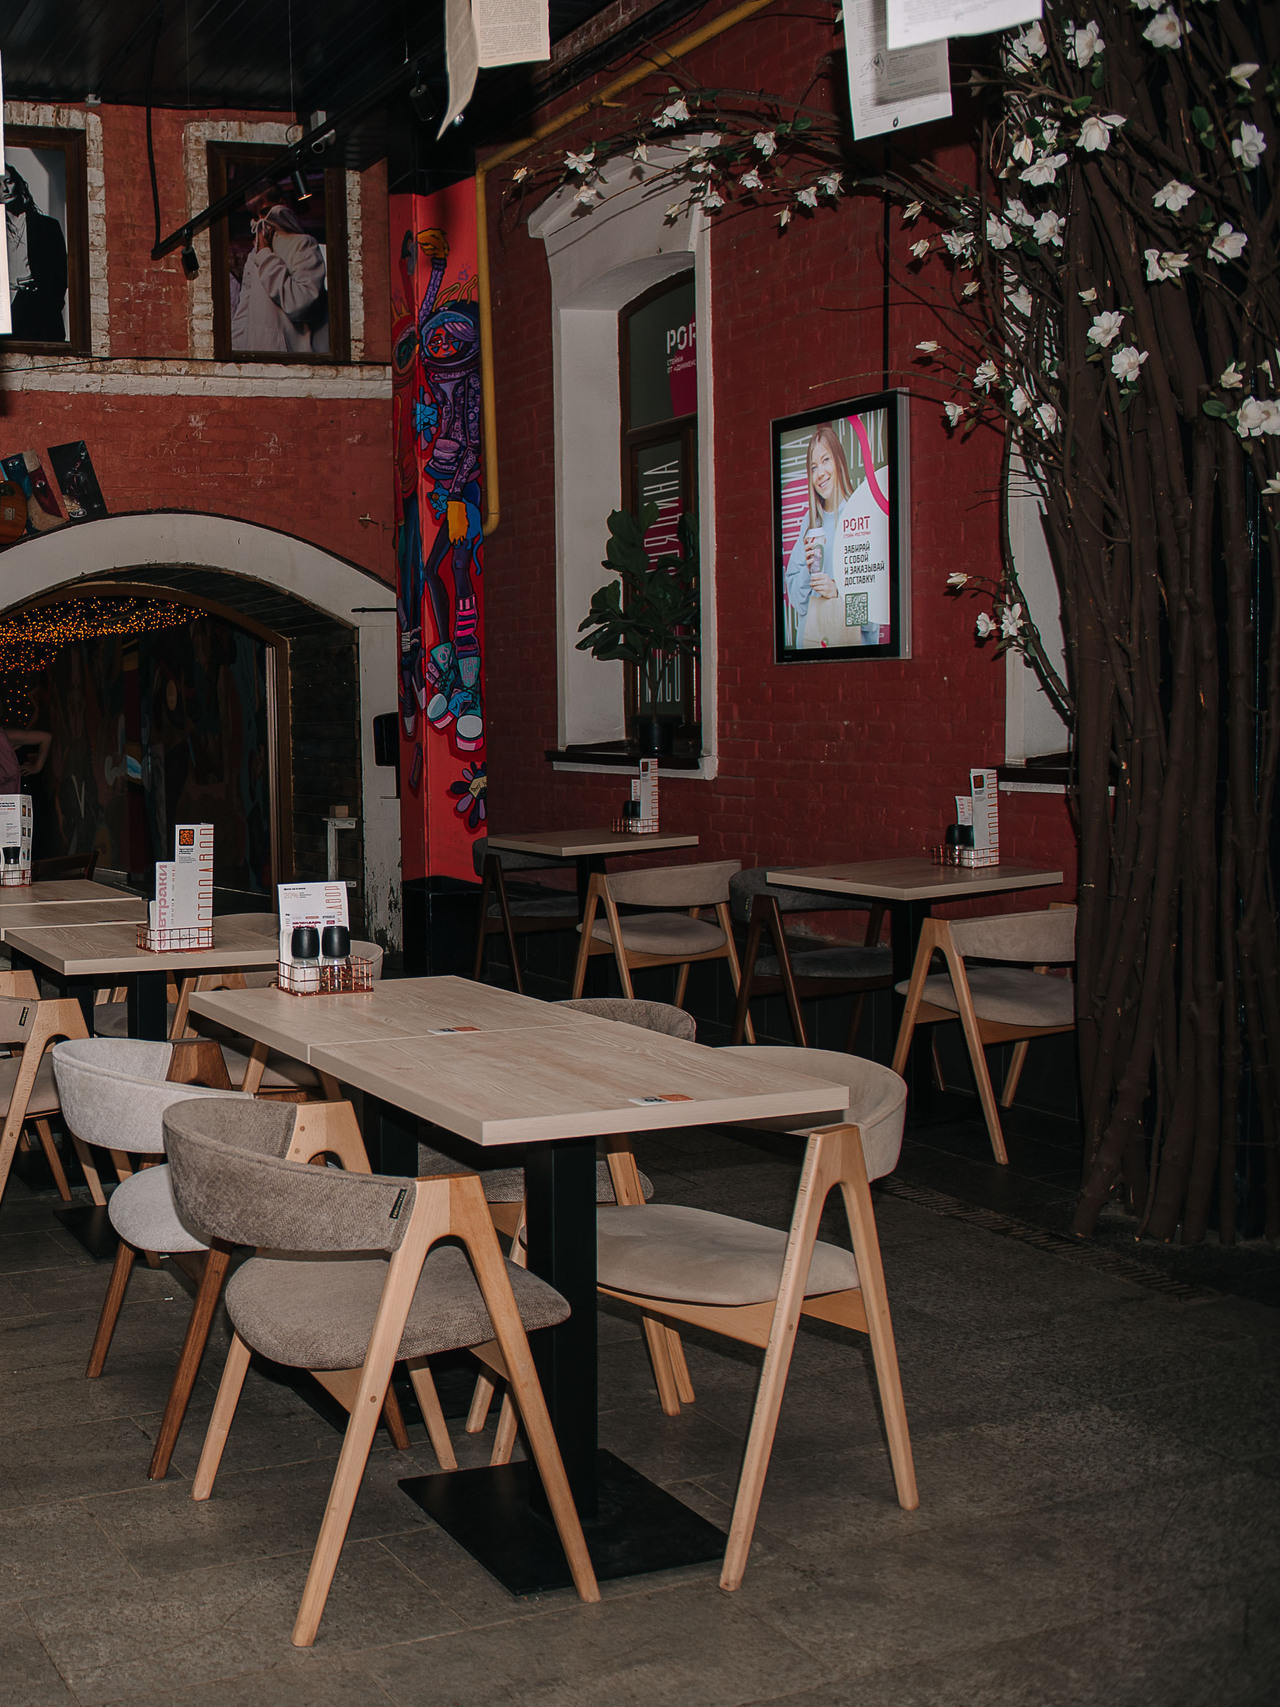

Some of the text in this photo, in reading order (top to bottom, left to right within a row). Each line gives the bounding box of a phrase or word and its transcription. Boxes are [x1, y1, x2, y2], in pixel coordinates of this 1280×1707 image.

[667, 322, 696, 354] POR
[843, 516, 871, 532] PORT
[844, 541, 870, 554] ЗАБИРАЙ
[844, 552, 869, 565] С СОБОЙ
[844, 561, 885, 575] И ЗАКАЗЫВАЙ
[844, 575, 875, 587] ДОСТАВКУ!
